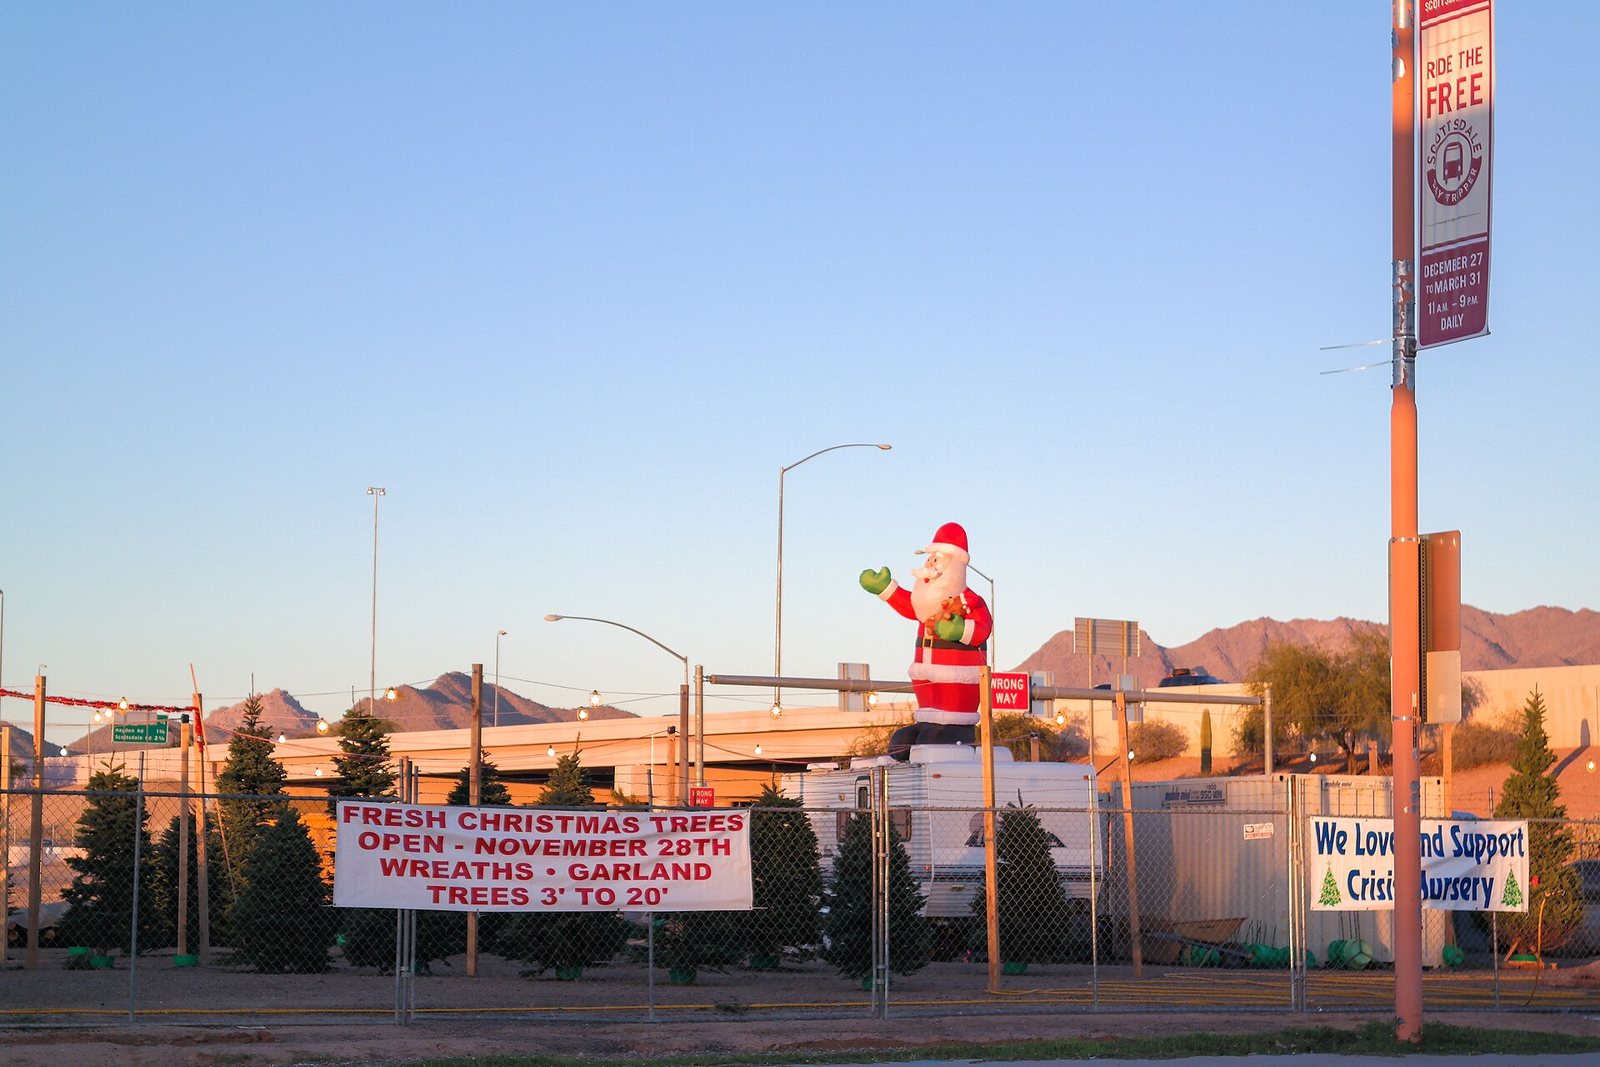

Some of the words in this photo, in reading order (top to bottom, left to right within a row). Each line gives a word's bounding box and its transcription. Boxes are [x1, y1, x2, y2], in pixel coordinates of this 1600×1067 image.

[1427, 55, 1453, 80] RIDE
[1458, 46, 1483, 69] THE
[1427, 72, 1483, 119] FREE
[1427, 118, 1482, 165] SCOTTSDALE
[1445, 167, 1478, 202] TRIPPER
[1424, 256, 1468, 278] DECEMBER
[1470, 252, 1483, 267] 27
[1425, 284, 1434, 294] TO
[1434, 274, 1467, 294] MARCH
[1469, 271, 1481, 286] 31
[1459, 294, 1466, 308] 9
[1441, 314, 1464, 331] DAILY
[991, 678, 1023, 690] WRONG
[995, 692, 1018, 704] WAY
[343, 806, 447, 829] FRESH
[457, 811, 640, 835] CHRISTMAS
[649, 814, 744, 833] TREES
[358, 831, 445, 854] OPEN
[475, 837, 649, 857] NOVEMBER
[657, 838, 731, 856] 28TH
[1315, 821, 1347, 856] We
[1420, 825, 1445, 858] nd
[1450, 825, 1525, 865] Support
[379, 858, 534, 881] WREATHS
[568, 862, 713, 881] GARLAND
[426, 885, 530, 906] TREES
[540, 887, 566, 906] 3'
[575, 887, 616, 906] TO
[626, 887, 669, 906] 20'
[1347, 868, 1395, 901] Crisi
